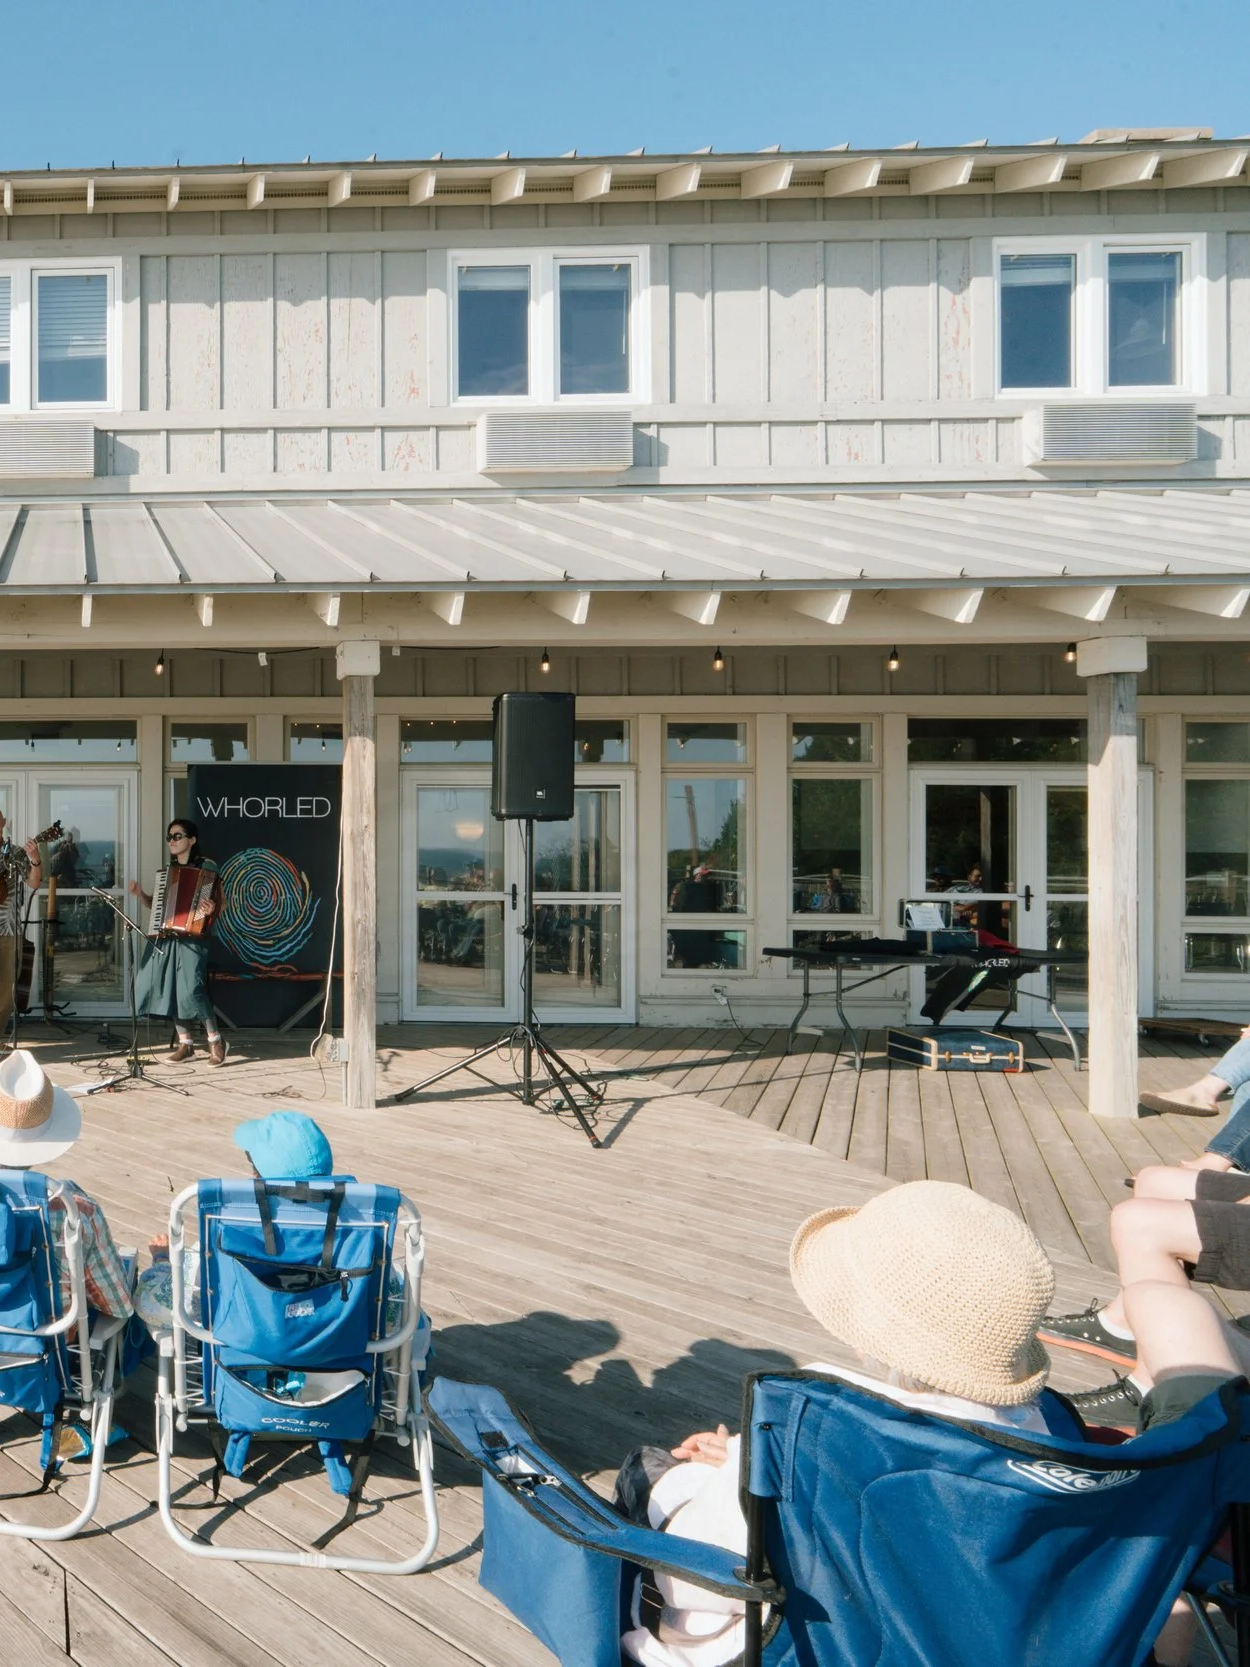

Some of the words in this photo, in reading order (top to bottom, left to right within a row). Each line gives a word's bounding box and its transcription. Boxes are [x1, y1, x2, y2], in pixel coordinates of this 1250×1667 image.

[196, 796, 331, 818] WHORLED
[261, 1417, 330, 1429] COOLER
[275, 1424, 313, 1433] POUCH
